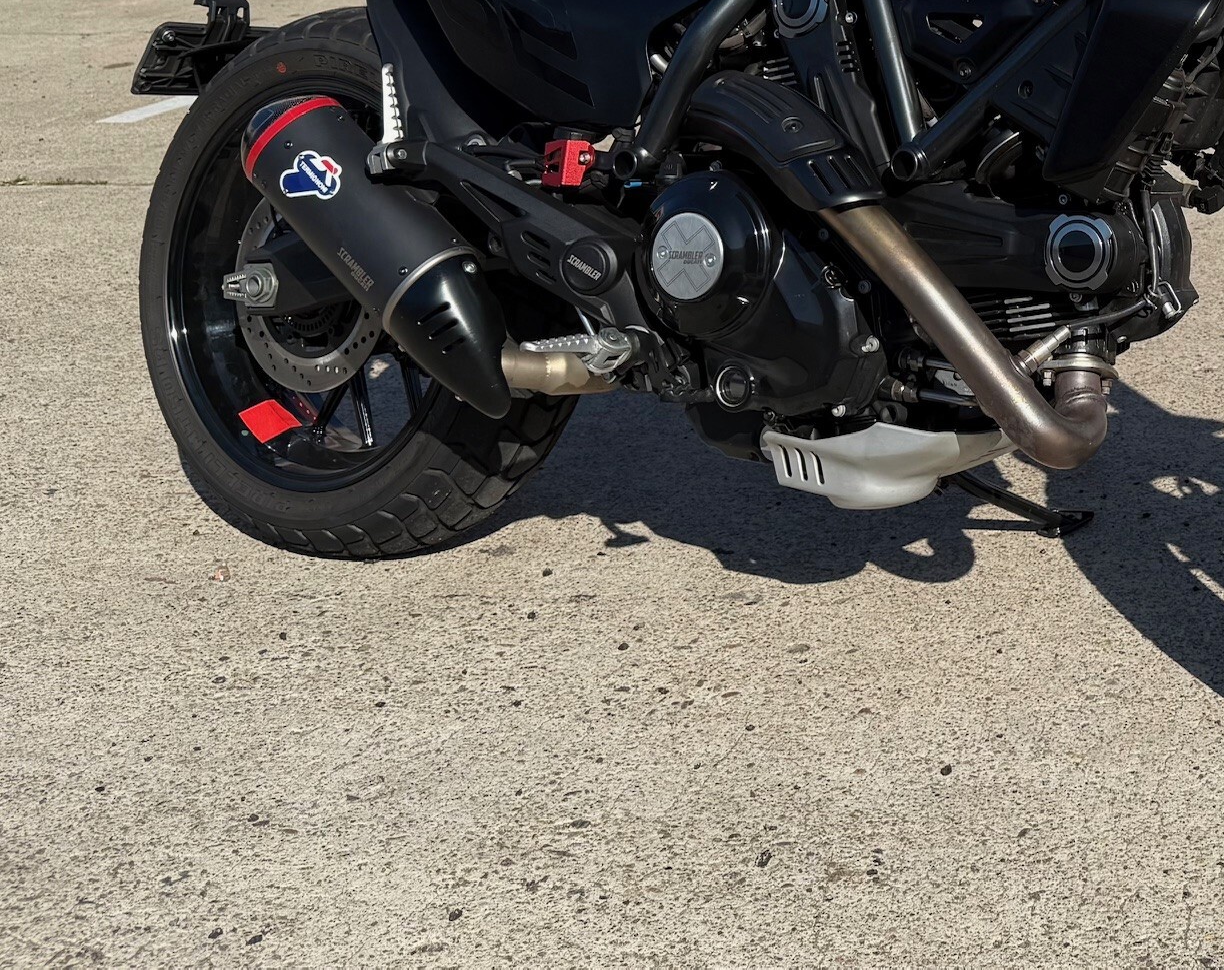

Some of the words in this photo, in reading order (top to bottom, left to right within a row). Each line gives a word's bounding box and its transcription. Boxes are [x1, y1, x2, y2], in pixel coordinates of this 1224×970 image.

[336, 247, 375, 288] SCRAMBLER
[566, 254, 602, 281] SCRAMBLER
[668, 250, 703, 260] SCRAMBLER
